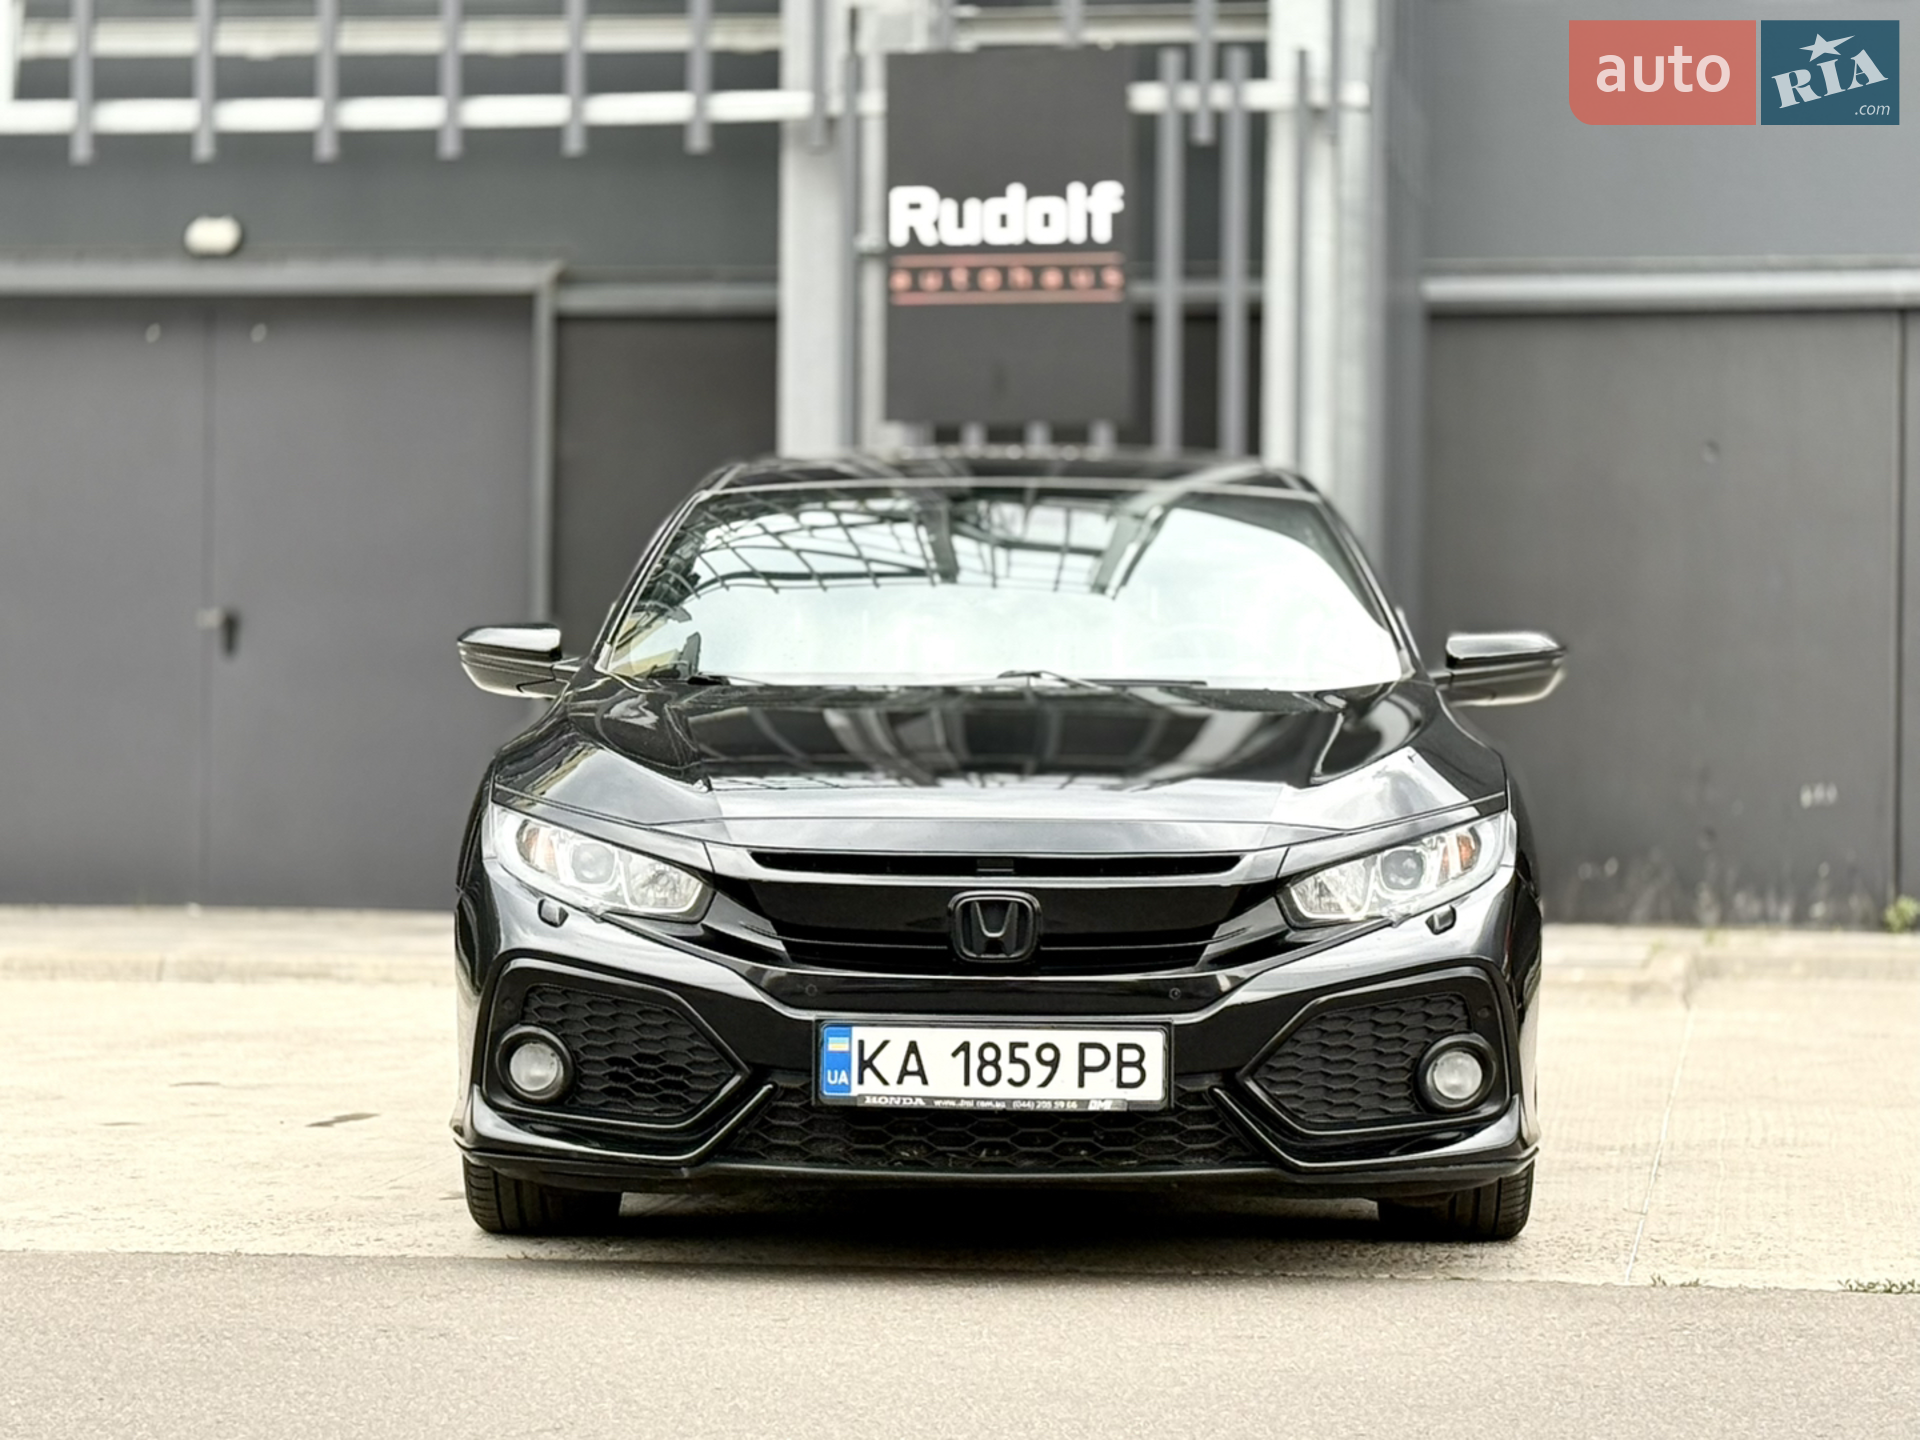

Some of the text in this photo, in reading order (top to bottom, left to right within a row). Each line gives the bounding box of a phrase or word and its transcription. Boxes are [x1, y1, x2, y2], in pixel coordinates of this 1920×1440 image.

[888, 180, 1125, 247] Rudolf
[827, 1069, 850, 1085] UA
[856, 1039, 1147, 1089] KA 1859 PB
[863, 1095, 926, 1106] HONDA
